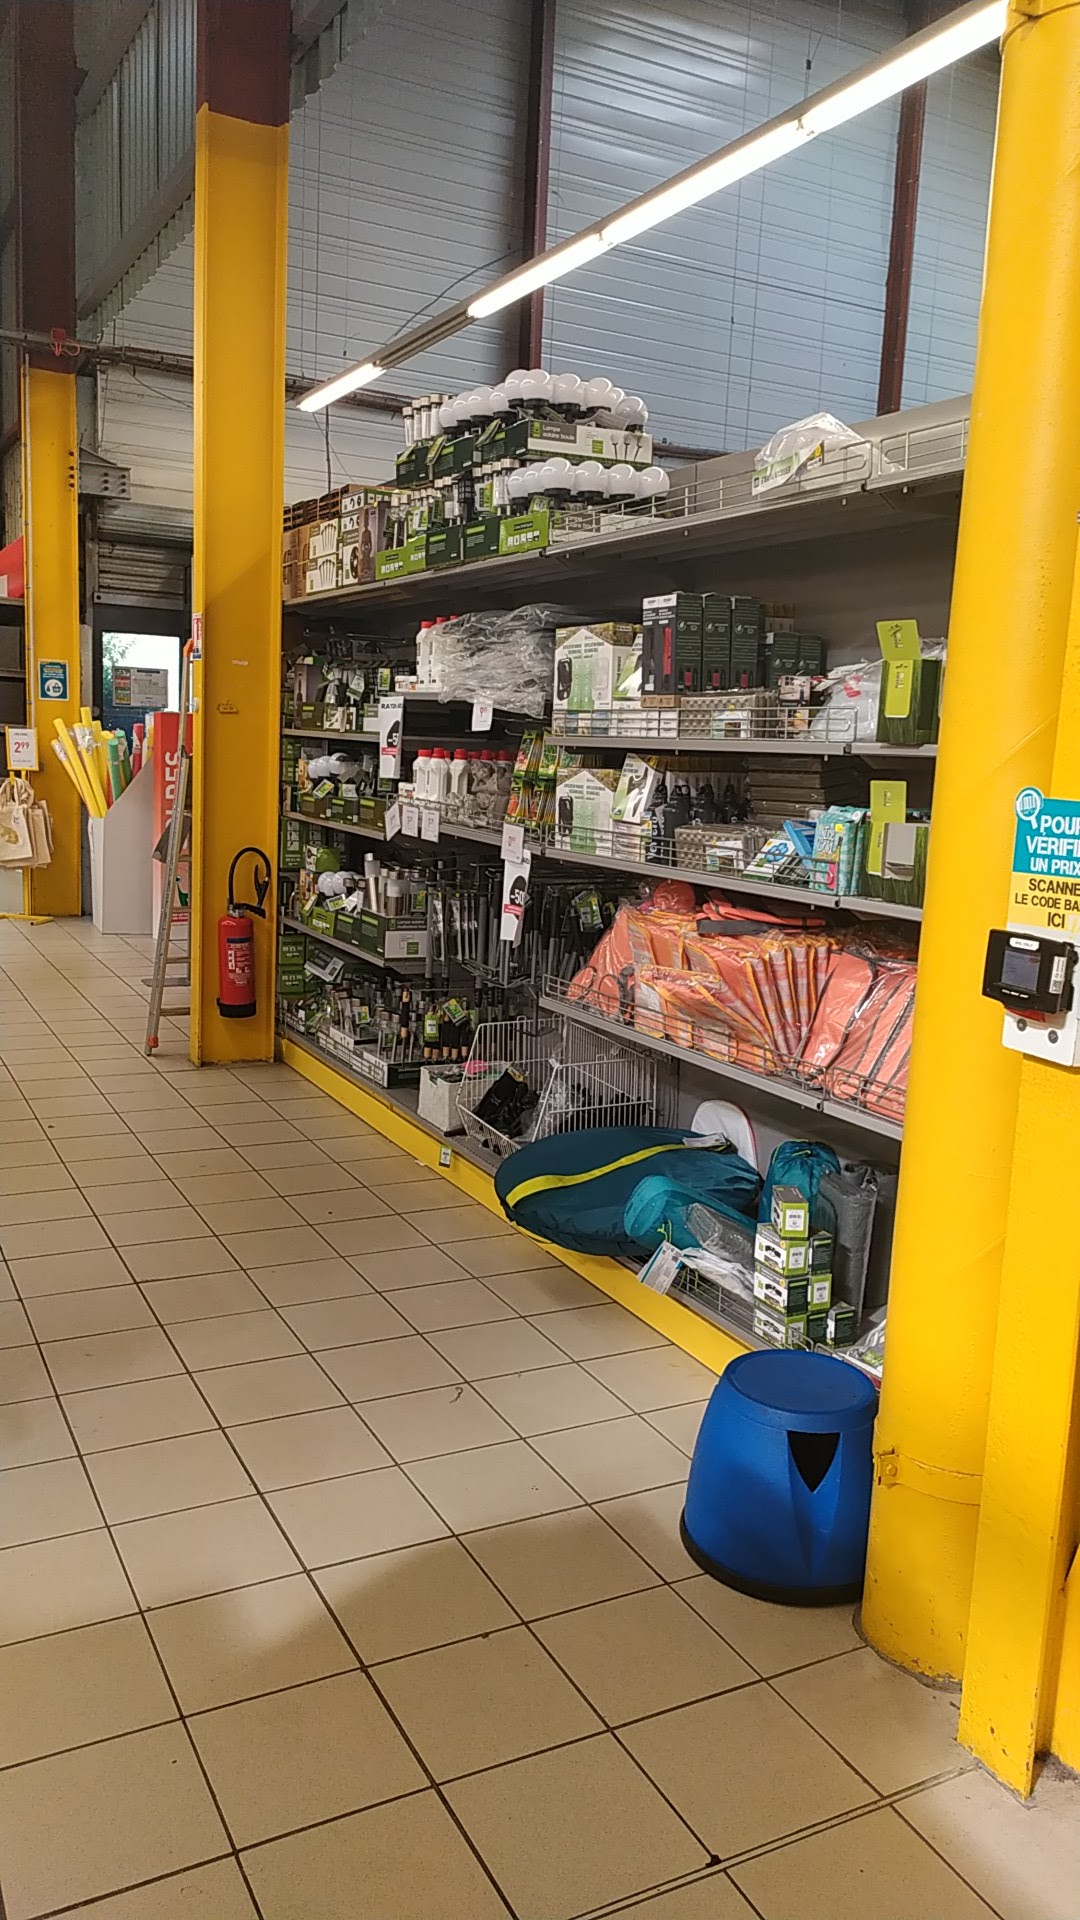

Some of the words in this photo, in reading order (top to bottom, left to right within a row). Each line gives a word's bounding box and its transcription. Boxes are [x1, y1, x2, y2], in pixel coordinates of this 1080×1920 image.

[542, 424, 561, 432] Lampe
[1030, 857, 1048, 872] UN
[1051, 859, 1080, 876] PRIX
[1028, 878, 1080, 897] SCANNE
[1014, 893, 1028, 905] LE
[1031, 895, 1061, 909] CODE
[1047, 912, 1065, 928] ICI
